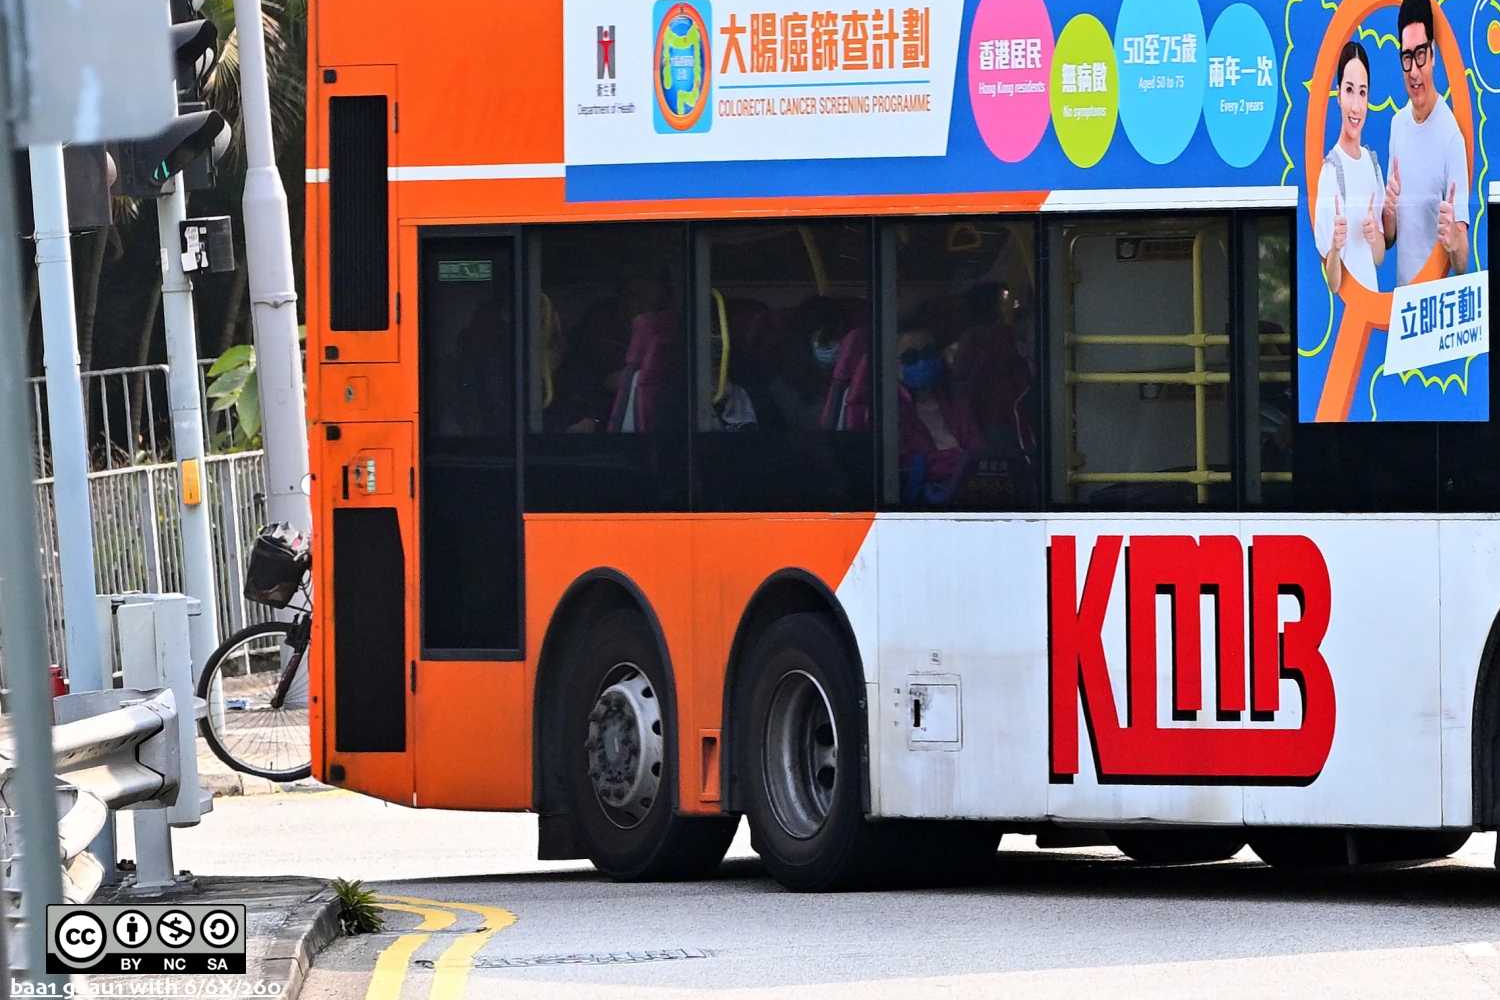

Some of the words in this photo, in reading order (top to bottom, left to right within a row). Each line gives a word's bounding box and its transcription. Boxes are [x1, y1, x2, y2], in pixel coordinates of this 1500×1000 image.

[720, 7, 930, 74] 大腸癌篩查計劃
[979, 38, 1042, 70] 香港居民
[1123, 33, 1197, 65] 50至75歲
[1138, 75, 1156, 92] Aged
[1156, 75, 1166, 89] 50
[1166, 75, 1173, 89] to
[1175, 75, 1184, 88] 75
[1209, 55, 1273, 88] 兩年一次
[978, 82, 996, 97] Hong
[997, 81, 1014, 96] Kong
[1014, 80, 1045, 94] residents
[718, 98, 777, 117] COLORECTAL
[780, 96, 817, 116] CANCER
[818, 95, 870, 115] SCREENING
[872, 94, 931, 113] PROGRAMME
[1219, 99, 1239, 115] Every
[1239, 99, 1245, 113] 2
[1245, 99, 1264, 114] years
[1400, 285, 1482, 341] 立即行動!
[1439, 332, 1456, 351] ACT
[1047, 534, 1337, 787] KMB
